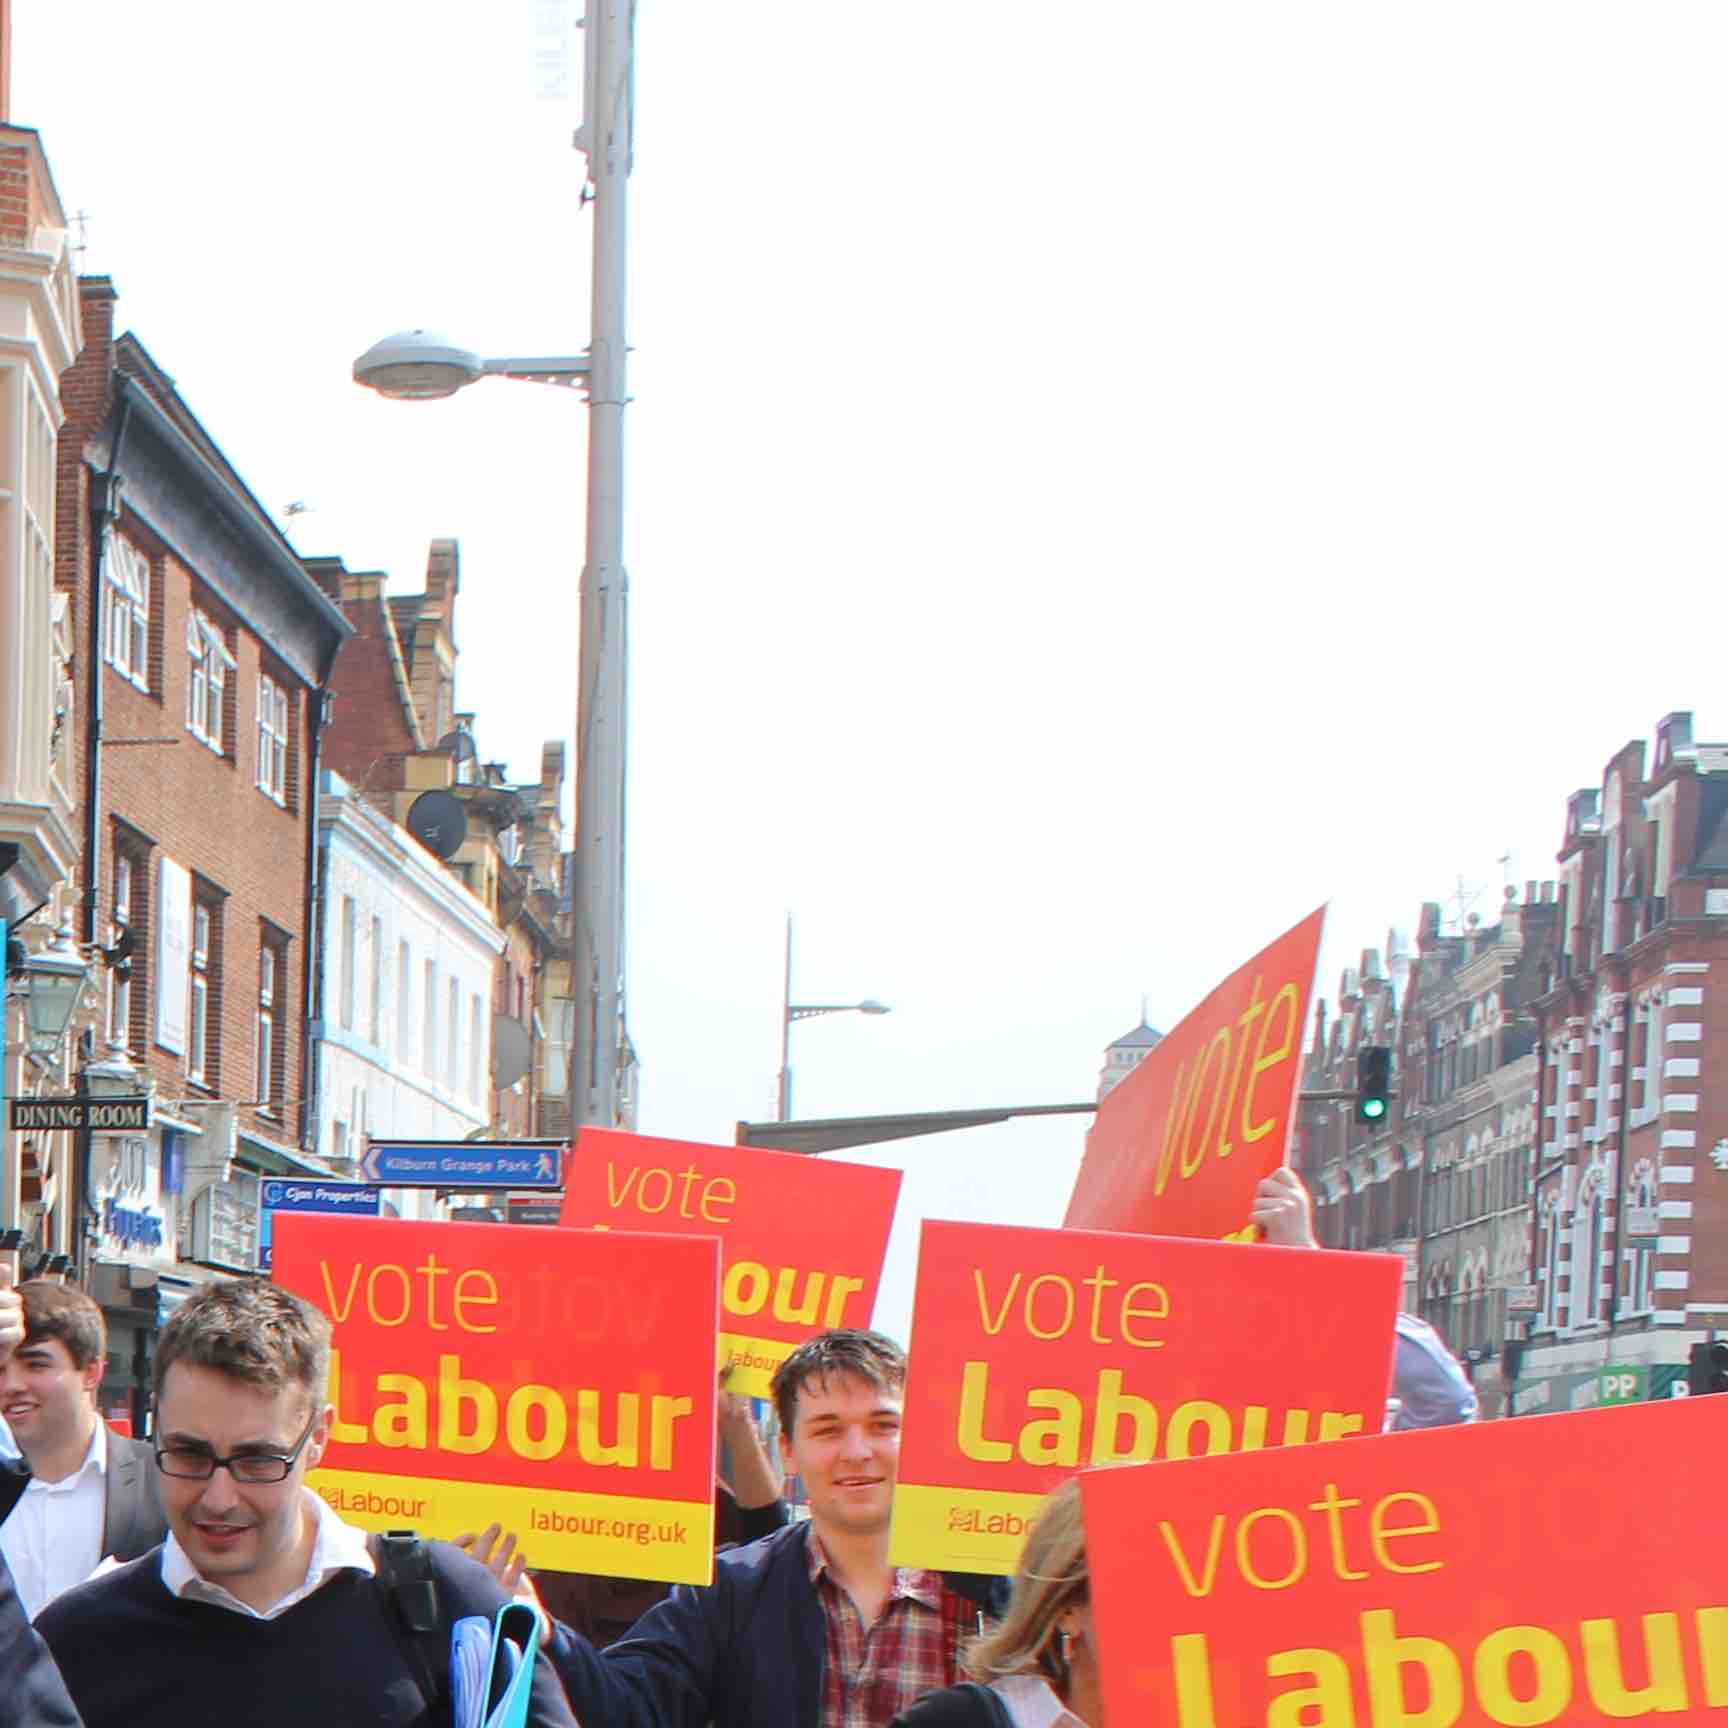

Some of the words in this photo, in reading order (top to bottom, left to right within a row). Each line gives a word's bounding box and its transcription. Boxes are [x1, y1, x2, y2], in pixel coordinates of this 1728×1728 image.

[15, 1104, 83, 1128] DINING
[87, 1104, 144, 1127] ROOM
[1153, 974, 1300, 1197] vote
[384, 1155, 438, 1172] Kilburn
[439, 1156, 494, 1175] Grange
[497, 1157, 532, 1172] Park
[605, 1155, 738, 1224] vote
[318, 1252, 500, 1335] vote
[722, 1259, 865, 1329] our
[973, 1265, 1171, 1350] vote
[324, 1347, 694, 1473] Labour
[339, 1487, 427, 1519] Labour
[529, 1507, 688, 1545] labour.org.uk
[1159, 1482, 1446, 1598] vote
